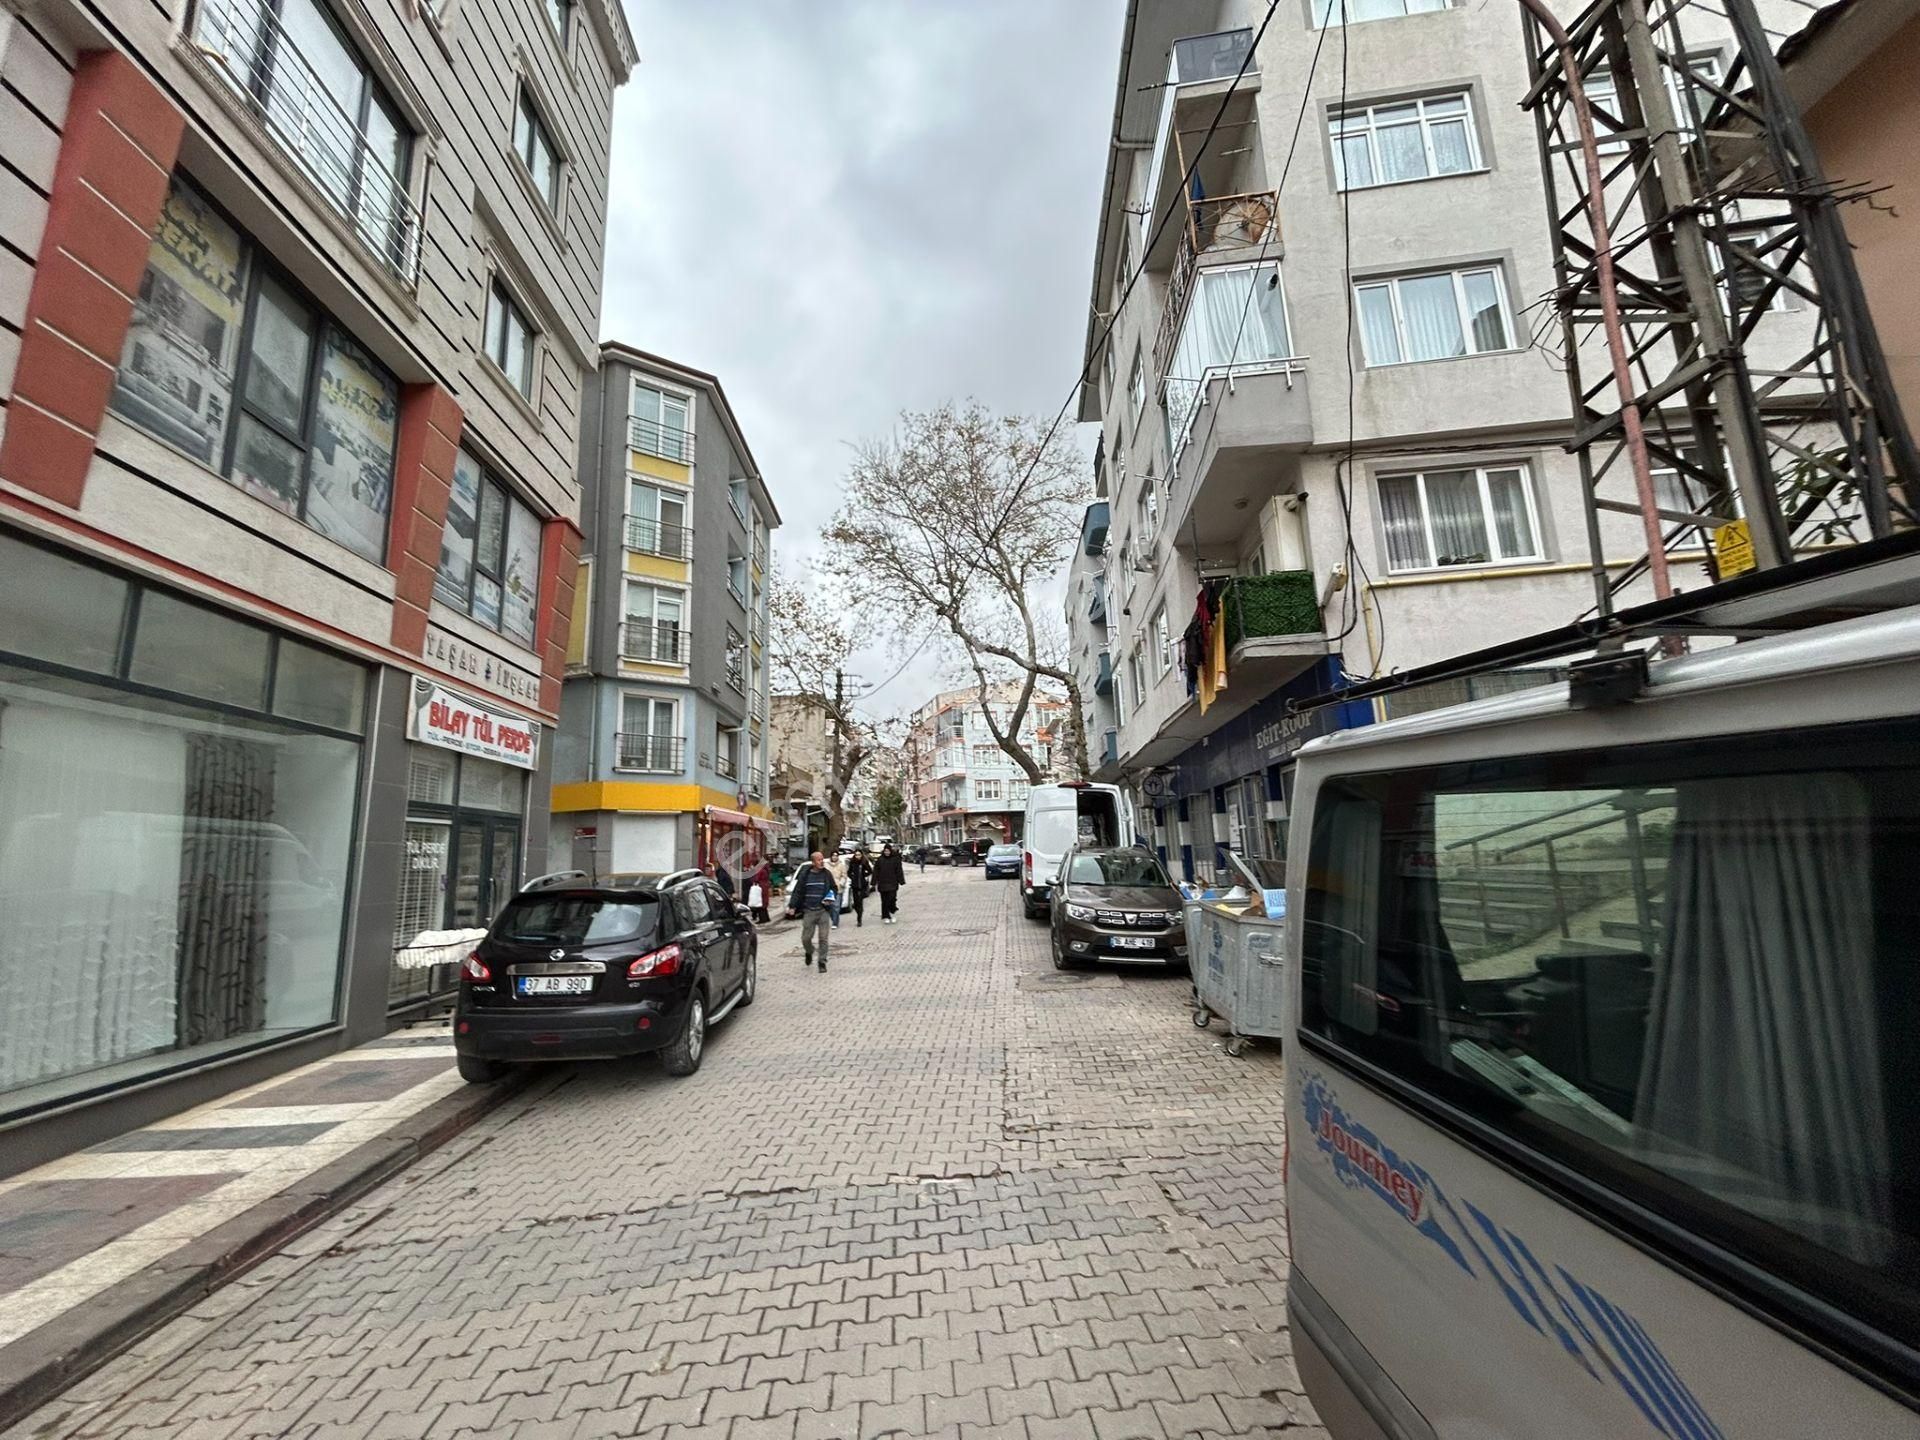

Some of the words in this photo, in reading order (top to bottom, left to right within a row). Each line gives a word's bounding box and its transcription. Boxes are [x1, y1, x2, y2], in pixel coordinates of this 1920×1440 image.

[429, 698, 470, 738] BİLAY
[472, 713, 494, 744] TÜL
[498, 724, 532, 755] PERDE
[525, 977, 538, 990] 37
[545, 977, 560, 990] AB
[566, 977, 587, 991] 990
[1318, 1107, 1424, 1223] Journey
